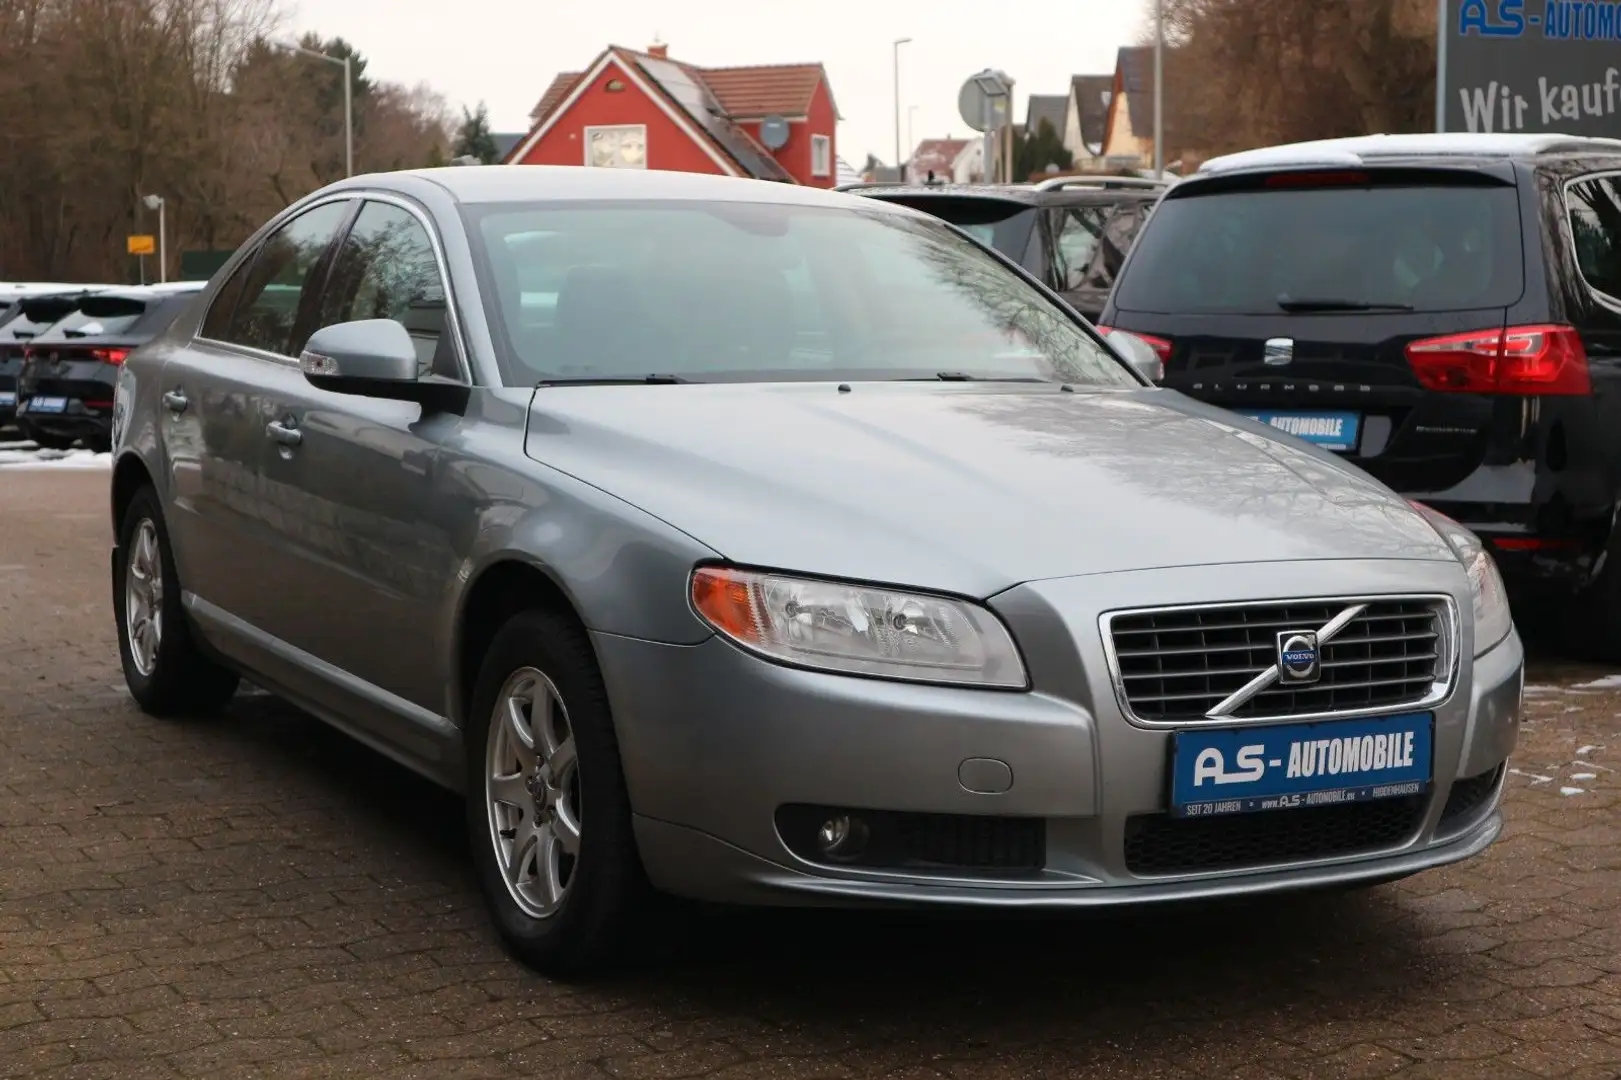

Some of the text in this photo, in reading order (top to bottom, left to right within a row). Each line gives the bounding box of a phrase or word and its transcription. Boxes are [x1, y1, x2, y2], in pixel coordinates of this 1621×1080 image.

[1459, 67, 1621, 133] Wir kauf
[1186, 804, 1202, 816] SEIT
[1203, 803, 1212, 814] 20
[1214, 800, 1242, 813] JAHREN
[1372, 783, 1419, 798] HIDDENHAUSEN
